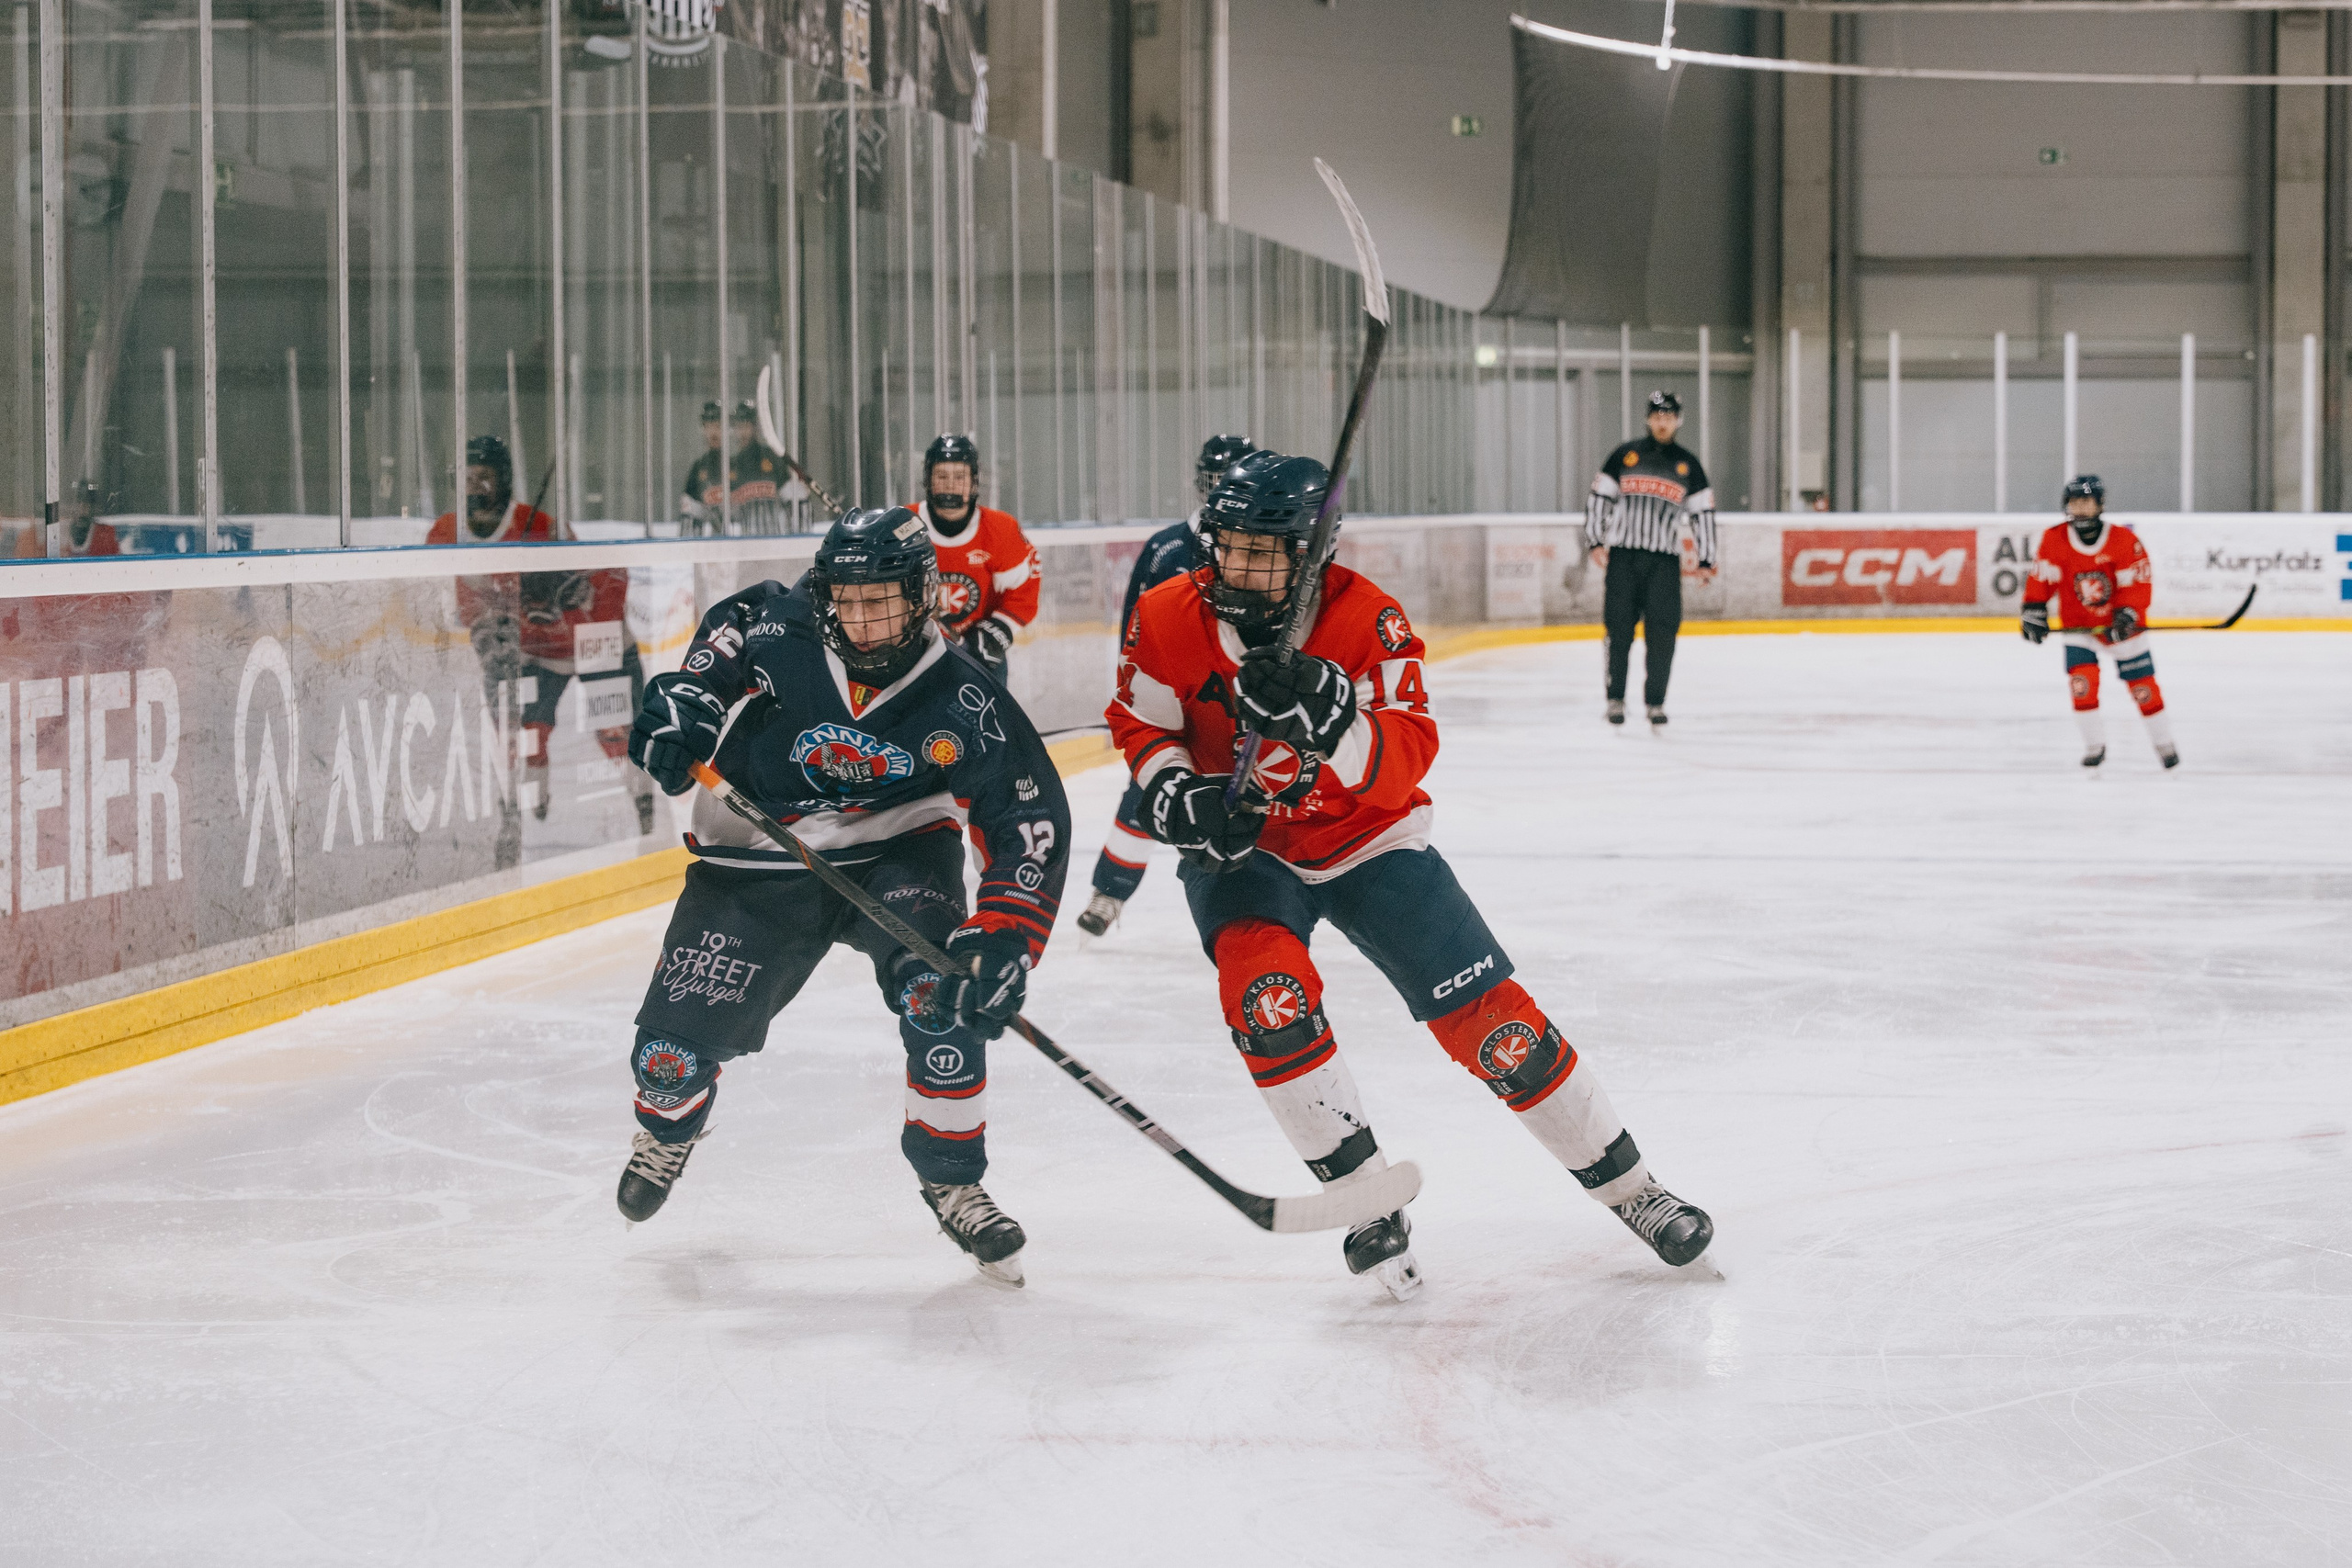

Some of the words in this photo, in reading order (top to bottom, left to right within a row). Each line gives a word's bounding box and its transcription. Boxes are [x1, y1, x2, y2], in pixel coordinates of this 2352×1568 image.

[1216, 498, 1249, 510] CCM
[833, 555, 868, 563] CCM
[1792, 547, 1967, 587] CCM
[1993, 536, 2033, 562] AL
[2206, 547, 2323, 576] Kurpfalz
[670, 682, 729, 716] CC
[1367, 660, 1430, 715] 14
[1151, 771, 1192, 839] CCM
[1018, 820, 1055, 866] 12
[884, 888, 921, 902] TOP
[926, 888, 947, 901] ON
[662, 958, 746, 1006] Burger
[666, 946, 763, 987] STREET
[1432, 953, 1495, 999] CCM
[1250, 975, 1306, 1020] KLOSTERSEE
[1484, 1025, 1538, 1053] KLOSTERSEE
[639, 1042, 695, 1077] MANNHEIM
